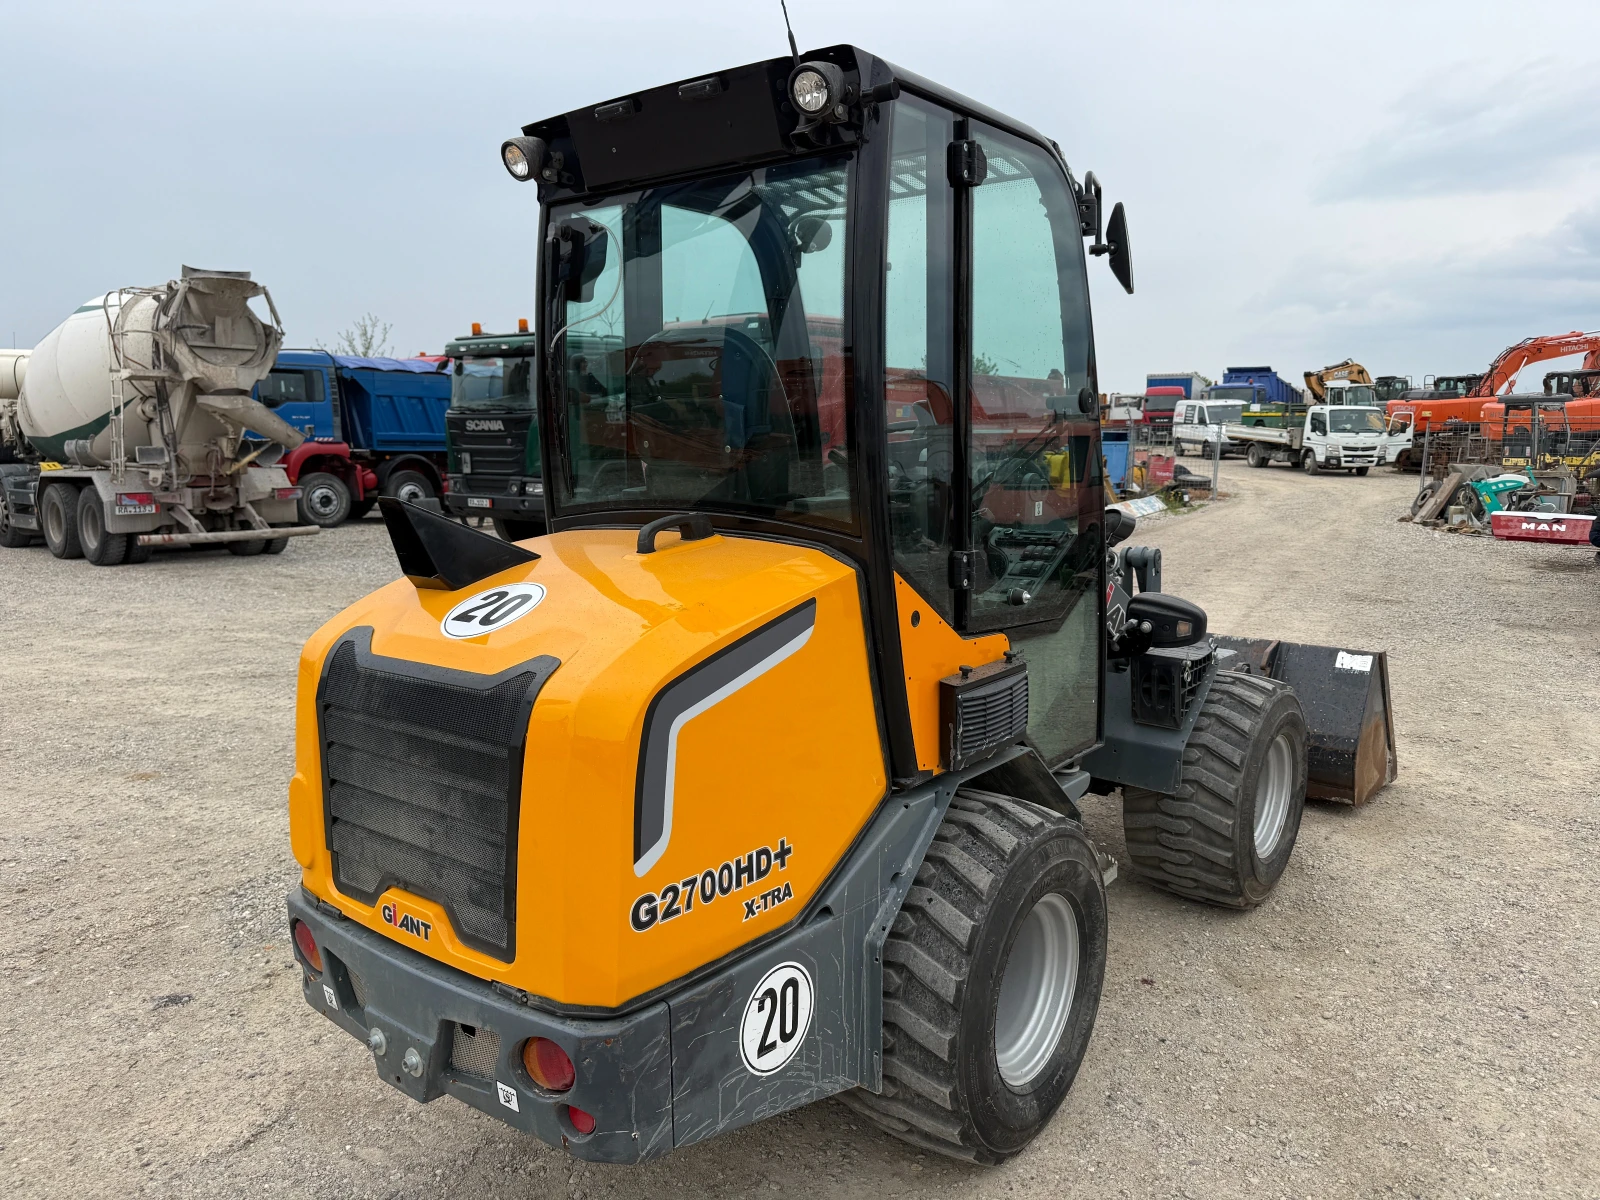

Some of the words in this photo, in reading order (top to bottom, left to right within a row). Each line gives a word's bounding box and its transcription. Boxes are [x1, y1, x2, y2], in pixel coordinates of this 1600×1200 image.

[1560, 343, 1589, 353] HITACHI
[1392, 404, 1416, 412] HITACHI
[465, 420, 505, 431] SCANIA
[1520, 522, 1567, 536] MAN
[451, 591, 532, 626] 20
[630, 837, 792, 933] G2700HD+
[742, 881, 794, 922] X-TRA
[757, 977, 799, 1060] 20
